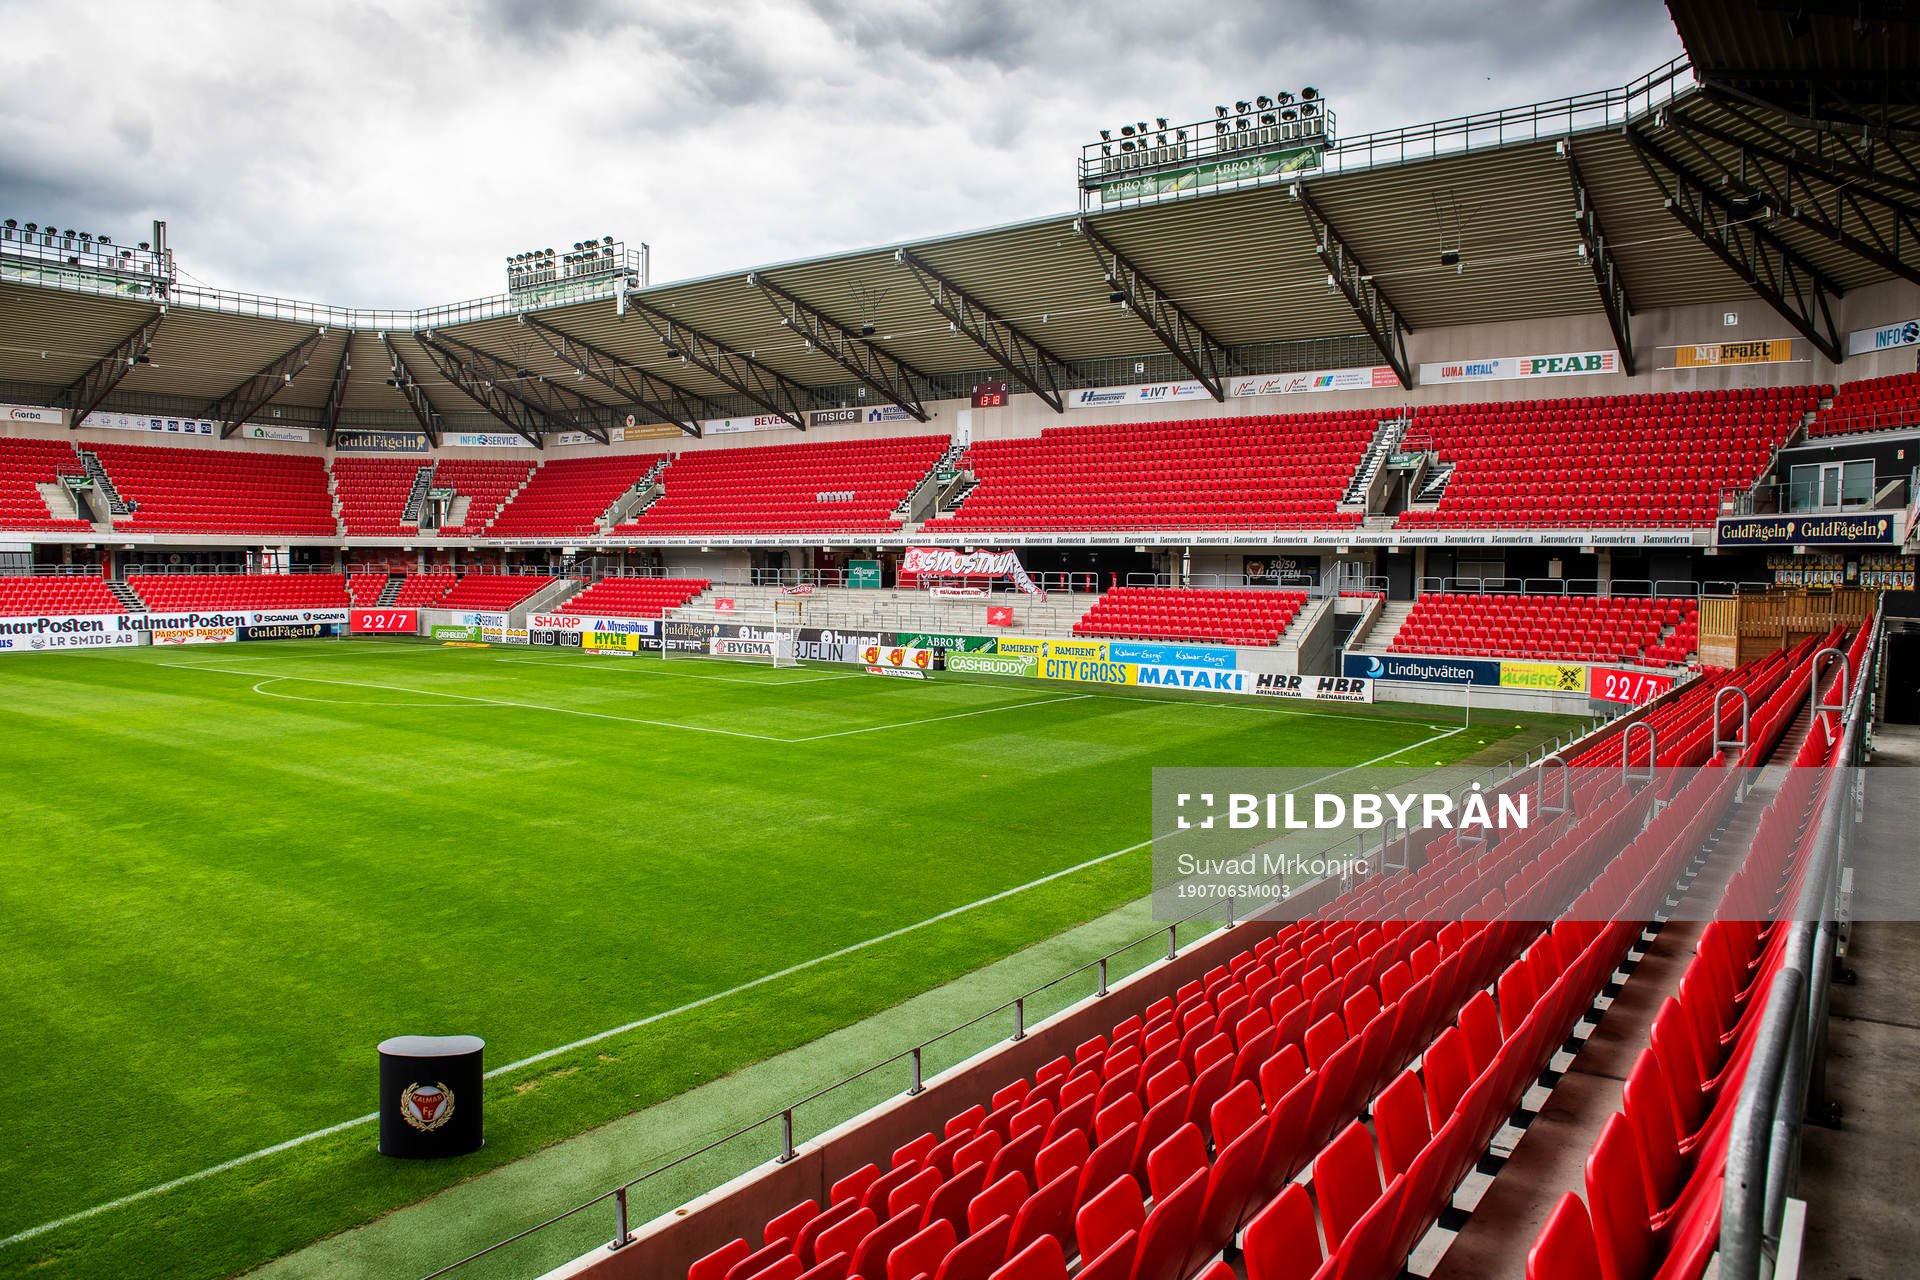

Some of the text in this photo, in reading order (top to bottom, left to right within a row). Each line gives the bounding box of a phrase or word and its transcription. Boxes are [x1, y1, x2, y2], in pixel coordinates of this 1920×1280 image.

[1875, 329, 1901, 348] INFO
[1441, 364, 1493, 378] LUMA METALL
[1530, 354, 1602, 375] PEAB
[1150, 386, 1168, 397] IVT
[817, 410, 855, 421] inside
[337, 433, 417, 450] GuldFågeln
[460, 435, 518, 446] INFO SERVICE
[1721, 520, 1877, 540] GuldFågeln GuldFågeln
[1197, 536, 1229, 544] Barometern
[1234, 536, 1267, 544] Barometern
[1273, 536, 1307, 544] Barometern
[1314, 535, 1349, 544] Barometern
[1356, 535, 1392, 544] Barometern
[1400, 535, 1438, 544] Barometern
[1444, 535, 1483, 544] Barometern
[1491, 535, 1533, 544] Barometern
[1540, 535, 1583, 544] Barometern
[1590, 535, 1636, 544] Barometern
[1643, 535, 1690, 544] Barometern
[1270, 560, 1297, 569] 50/50
[1265, 569, 1302, 579] LOTTEN
[117, 613, 246, 632] KalmarPosten
[264, 614, 299, 622] SCANIA
[362, 614, 407, 629] 22/7
[482, 616, 503, 627] SERVICE
[534, 616, 580, 629] SHARP
[155, 627, 235, 639] PARSONS PARSONS
[247, 625, 315, 639] GuldFågeln
[607, 621, 648, 634] Myresjöhus
[50, 633, 133, 647] LR SMIDE AB
[594, 633, 627, 645] HYLTE
[640, 638, 702, 650] TEXSTAR
[727, 642, 772, 654] BYGMA
[1000, 643, 1096, 657] RAMIRENT RAMIRENT
[950, 658, 1026, 676] CASHBUDDY
[1046, 659, 1127, 684] CITY GROSS
[1388, 662, 1474, 680] Lindbytvätten
[1138, 667, 1243, 690] MATAKI
[1256, 674, 1365, 693] HBR HBR
[1255, 690, 1365, 702] ARENAREKLAM ARENAREKLAM
[413, 1094, 443, 1104] KALMAR
